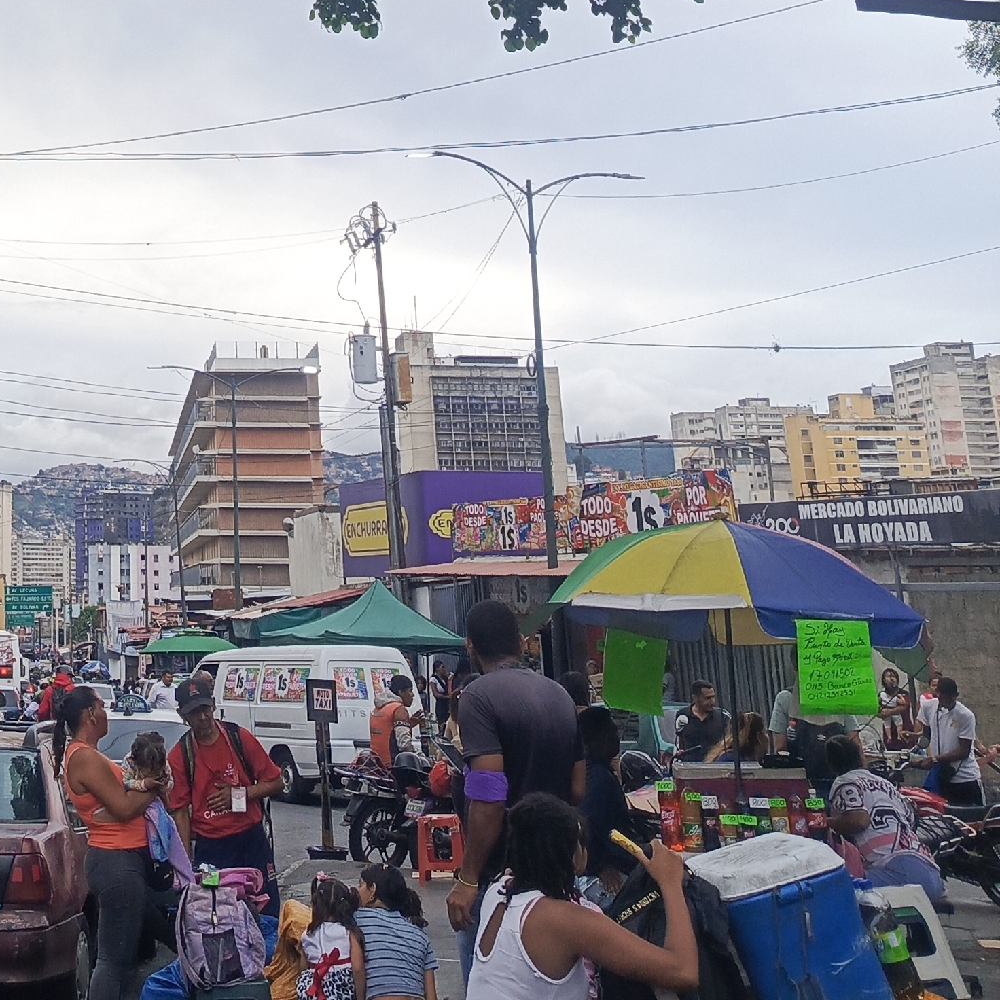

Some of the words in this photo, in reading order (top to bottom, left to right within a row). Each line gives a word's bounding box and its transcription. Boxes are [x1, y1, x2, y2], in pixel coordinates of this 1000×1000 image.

[685, 485, 708, 506] POR
[465, 504, 485, 515] TODO
[536, 498, 546, 510] PO
[581, 496, 612, 516] TODO
[798, 501, 864, 520] MERCADO
[868, 495, 964, 517] BOLIVARIANO
[464, 515, 487, 528] DESDE
[677, 509, 721, 525] PAQUET
[580, 517, 619, 538] DESDE
[833, 523, 856, 544] LA
[858, 520, 933, 543] HOYADA
[804, 623, 820, 636] Si
[822, 622, 846, 639] Hay
[803, 637, 832, 650] Punto
[833, 639, 844, 648] de
[845, 637, 867, 649] Venta
[813, 650, 831, 667] Pago
[316, 689, 330, 699] MOTO
[315, 698, 332, 710] TAXI
